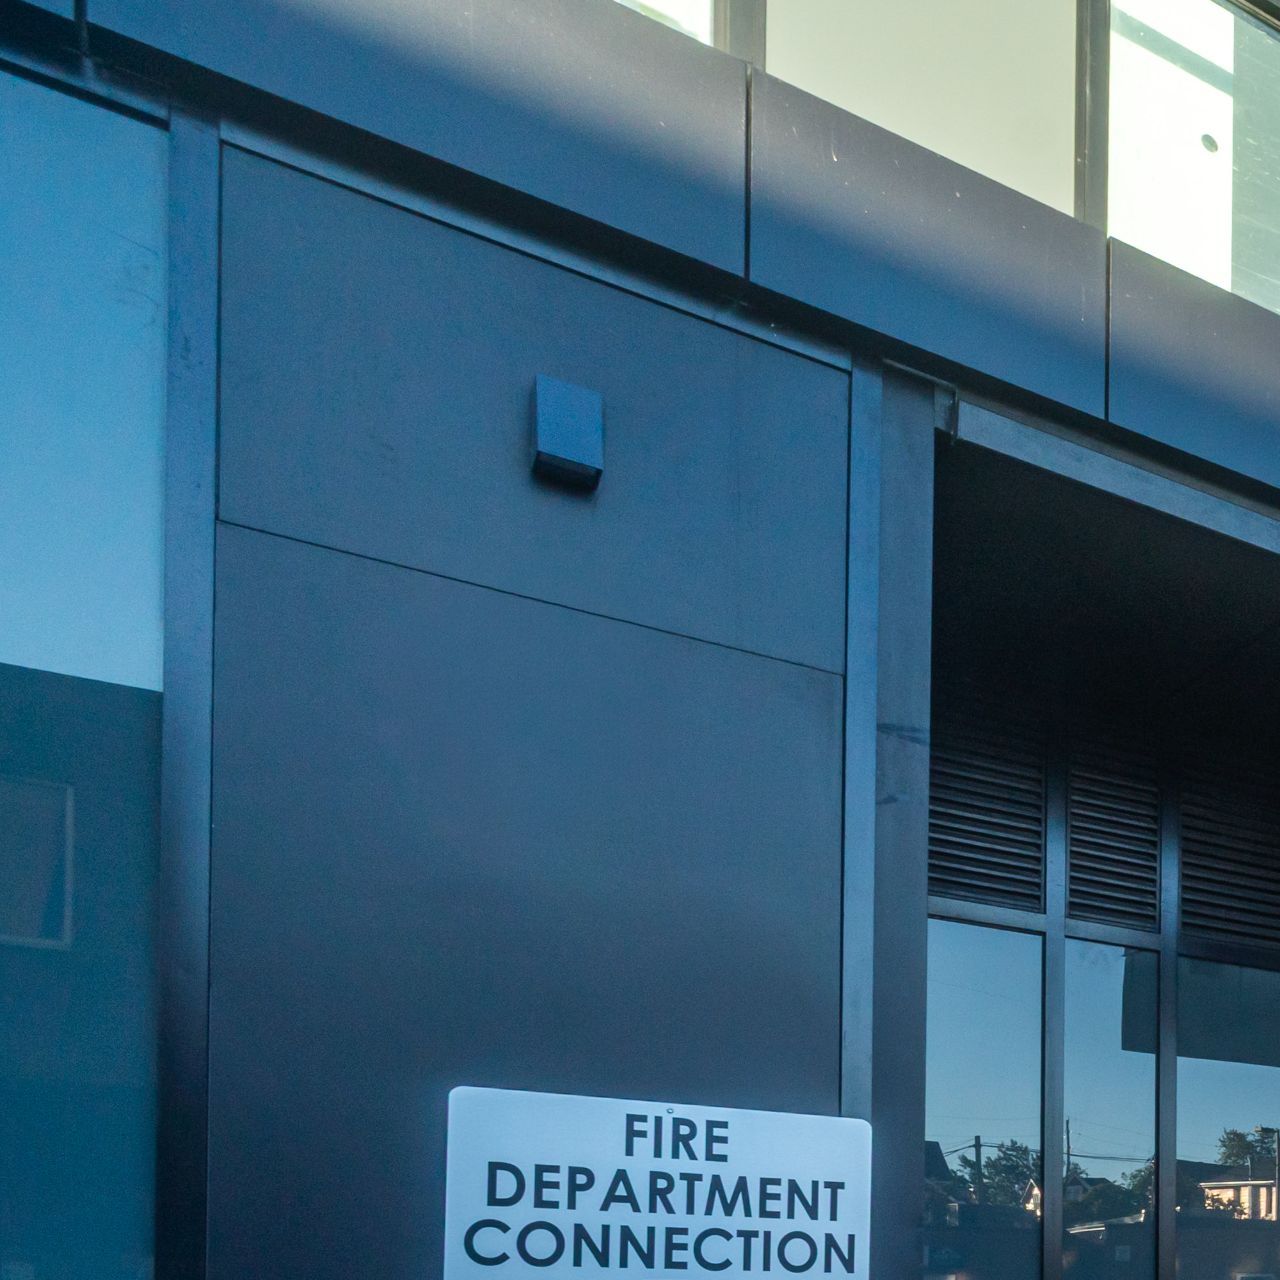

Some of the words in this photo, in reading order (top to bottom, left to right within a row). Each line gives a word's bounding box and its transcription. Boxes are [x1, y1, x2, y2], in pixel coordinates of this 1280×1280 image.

[625, 1113, 729, 1163] FIRE
[487, 1161, 845, 1221] DEPARTMENT
[463, 1219, 855, 1274] CONNECTION
